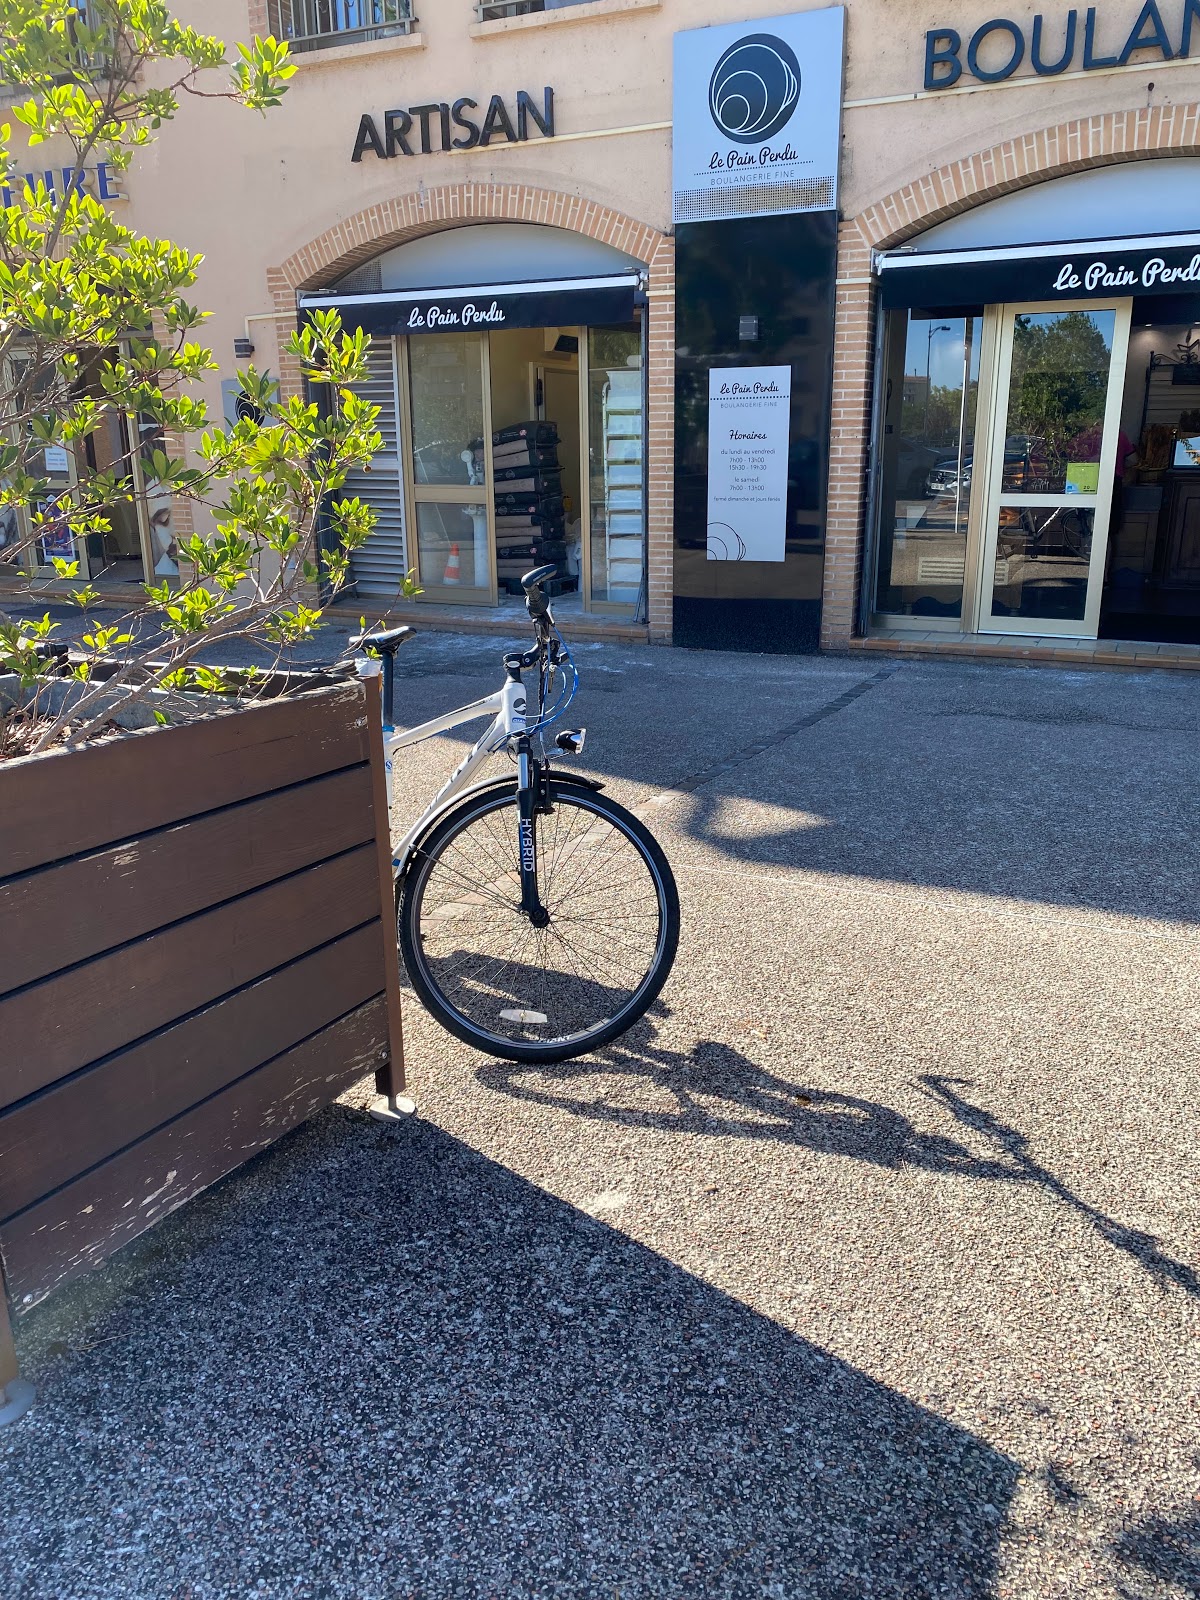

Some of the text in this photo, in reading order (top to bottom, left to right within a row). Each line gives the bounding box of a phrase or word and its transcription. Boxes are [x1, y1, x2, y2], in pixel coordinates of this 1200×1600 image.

[350, 86, 555, 163] ARTISAN
[726, 150, 757, 169] Pain
[758, 143, 799, 165] Perdu
[710, 169, 795, 186] BOULANGERIE FINE
[1052, 253, 1200, 291] Le Pain Perd
[407, 300, 506, 328] Le Pain Perdu
[732, 383, 752, 394] Pain
[753, 381, 779, 394] Perdu
[729, 429, 767, 440] Horaires
[521, 818, 535, 872] HYBRID
